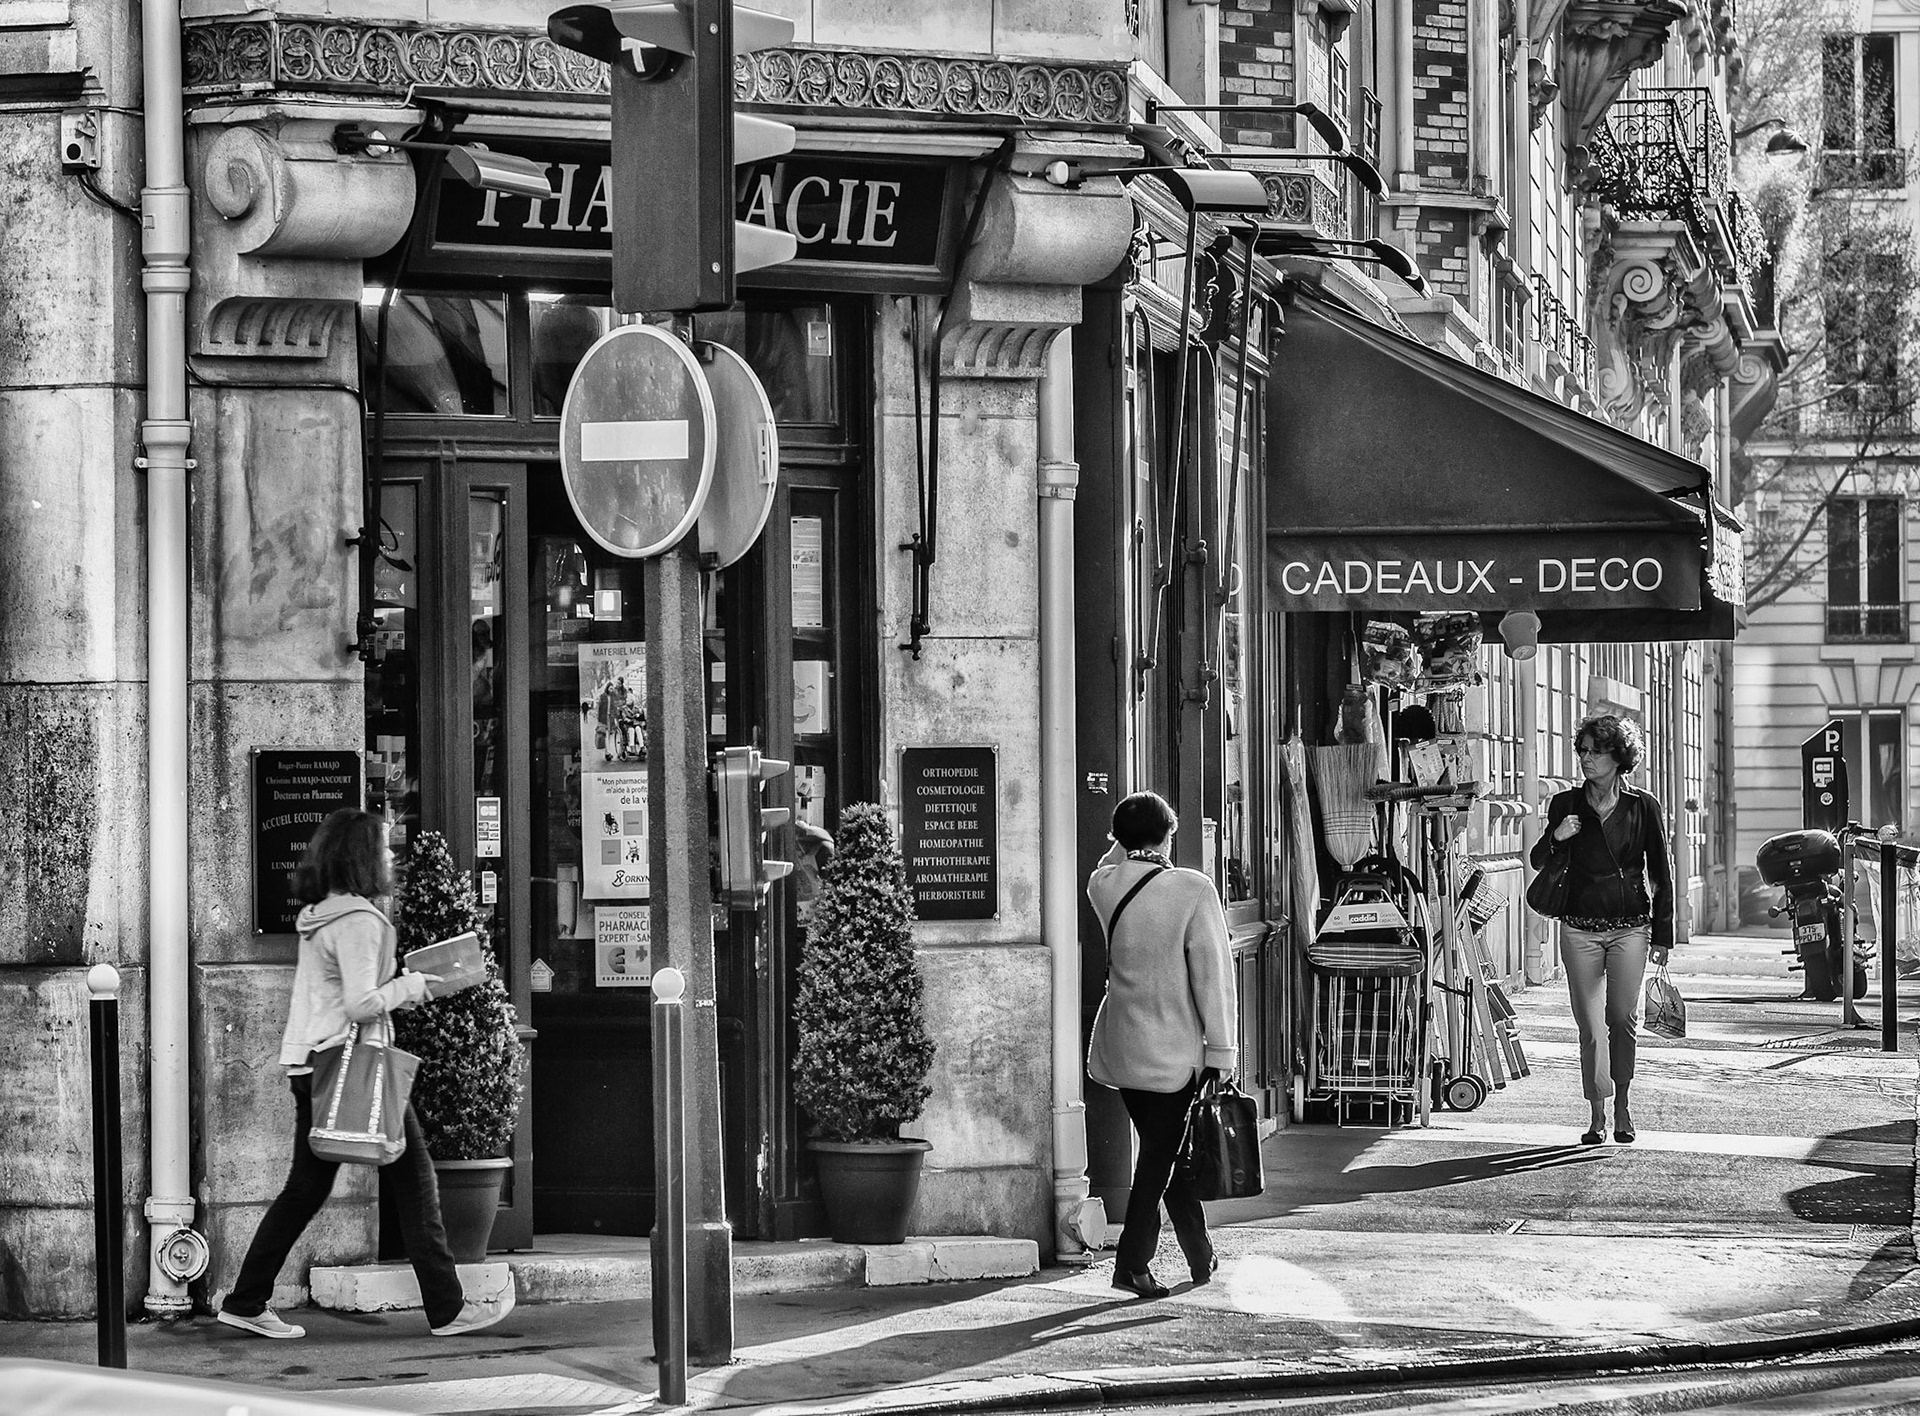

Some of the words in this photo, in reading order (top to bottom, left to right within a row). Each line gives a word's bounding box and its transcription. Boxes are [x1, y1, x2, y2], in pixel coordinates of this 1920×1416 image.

[1281, 559, 1496, 595] CADEAUX
[1538, 557, 1663, 593] DECO
[592, 647, 628, 657] MATERIEL
[313, 760, 340, 771] RAMAJO
[922, 767, 979, 778] ORTHOPEDIE
[292, 775, 352, 786] RAMAJO-ANCOURT
[273, 790, 301, 800] Docteurs
[302, 792, 310, 800] en
[311, 788, 343, 800] Pharmacie
[916, 785, 986, 796] COSMETOLOGIE
[620, 796, 631, 805] de
[632, 795, 640, 804] la
[925, 802, 978, 815] DIETETIQUE
[261, 812, 293, 832] ACCUEIL
[293, 812, 323, 824] ECOUTE
[924, 820, 956, 831] ESPACE
[957, 820, 979, 830] BEBE
[920, 838, 984, 849] HOMEOPATHIE
[271, 861, 295, 870] LUNDI
[912, 856, 991, 866] PHYTHOTHERAPIE
[915, 873, 989, 883] AROMATHERAPIE
[919, 890, 986, 901] HERBORISTERIE
[618, 911, 647, 919] CONSEIL
[598, 933, 629, 943] EXPERT
